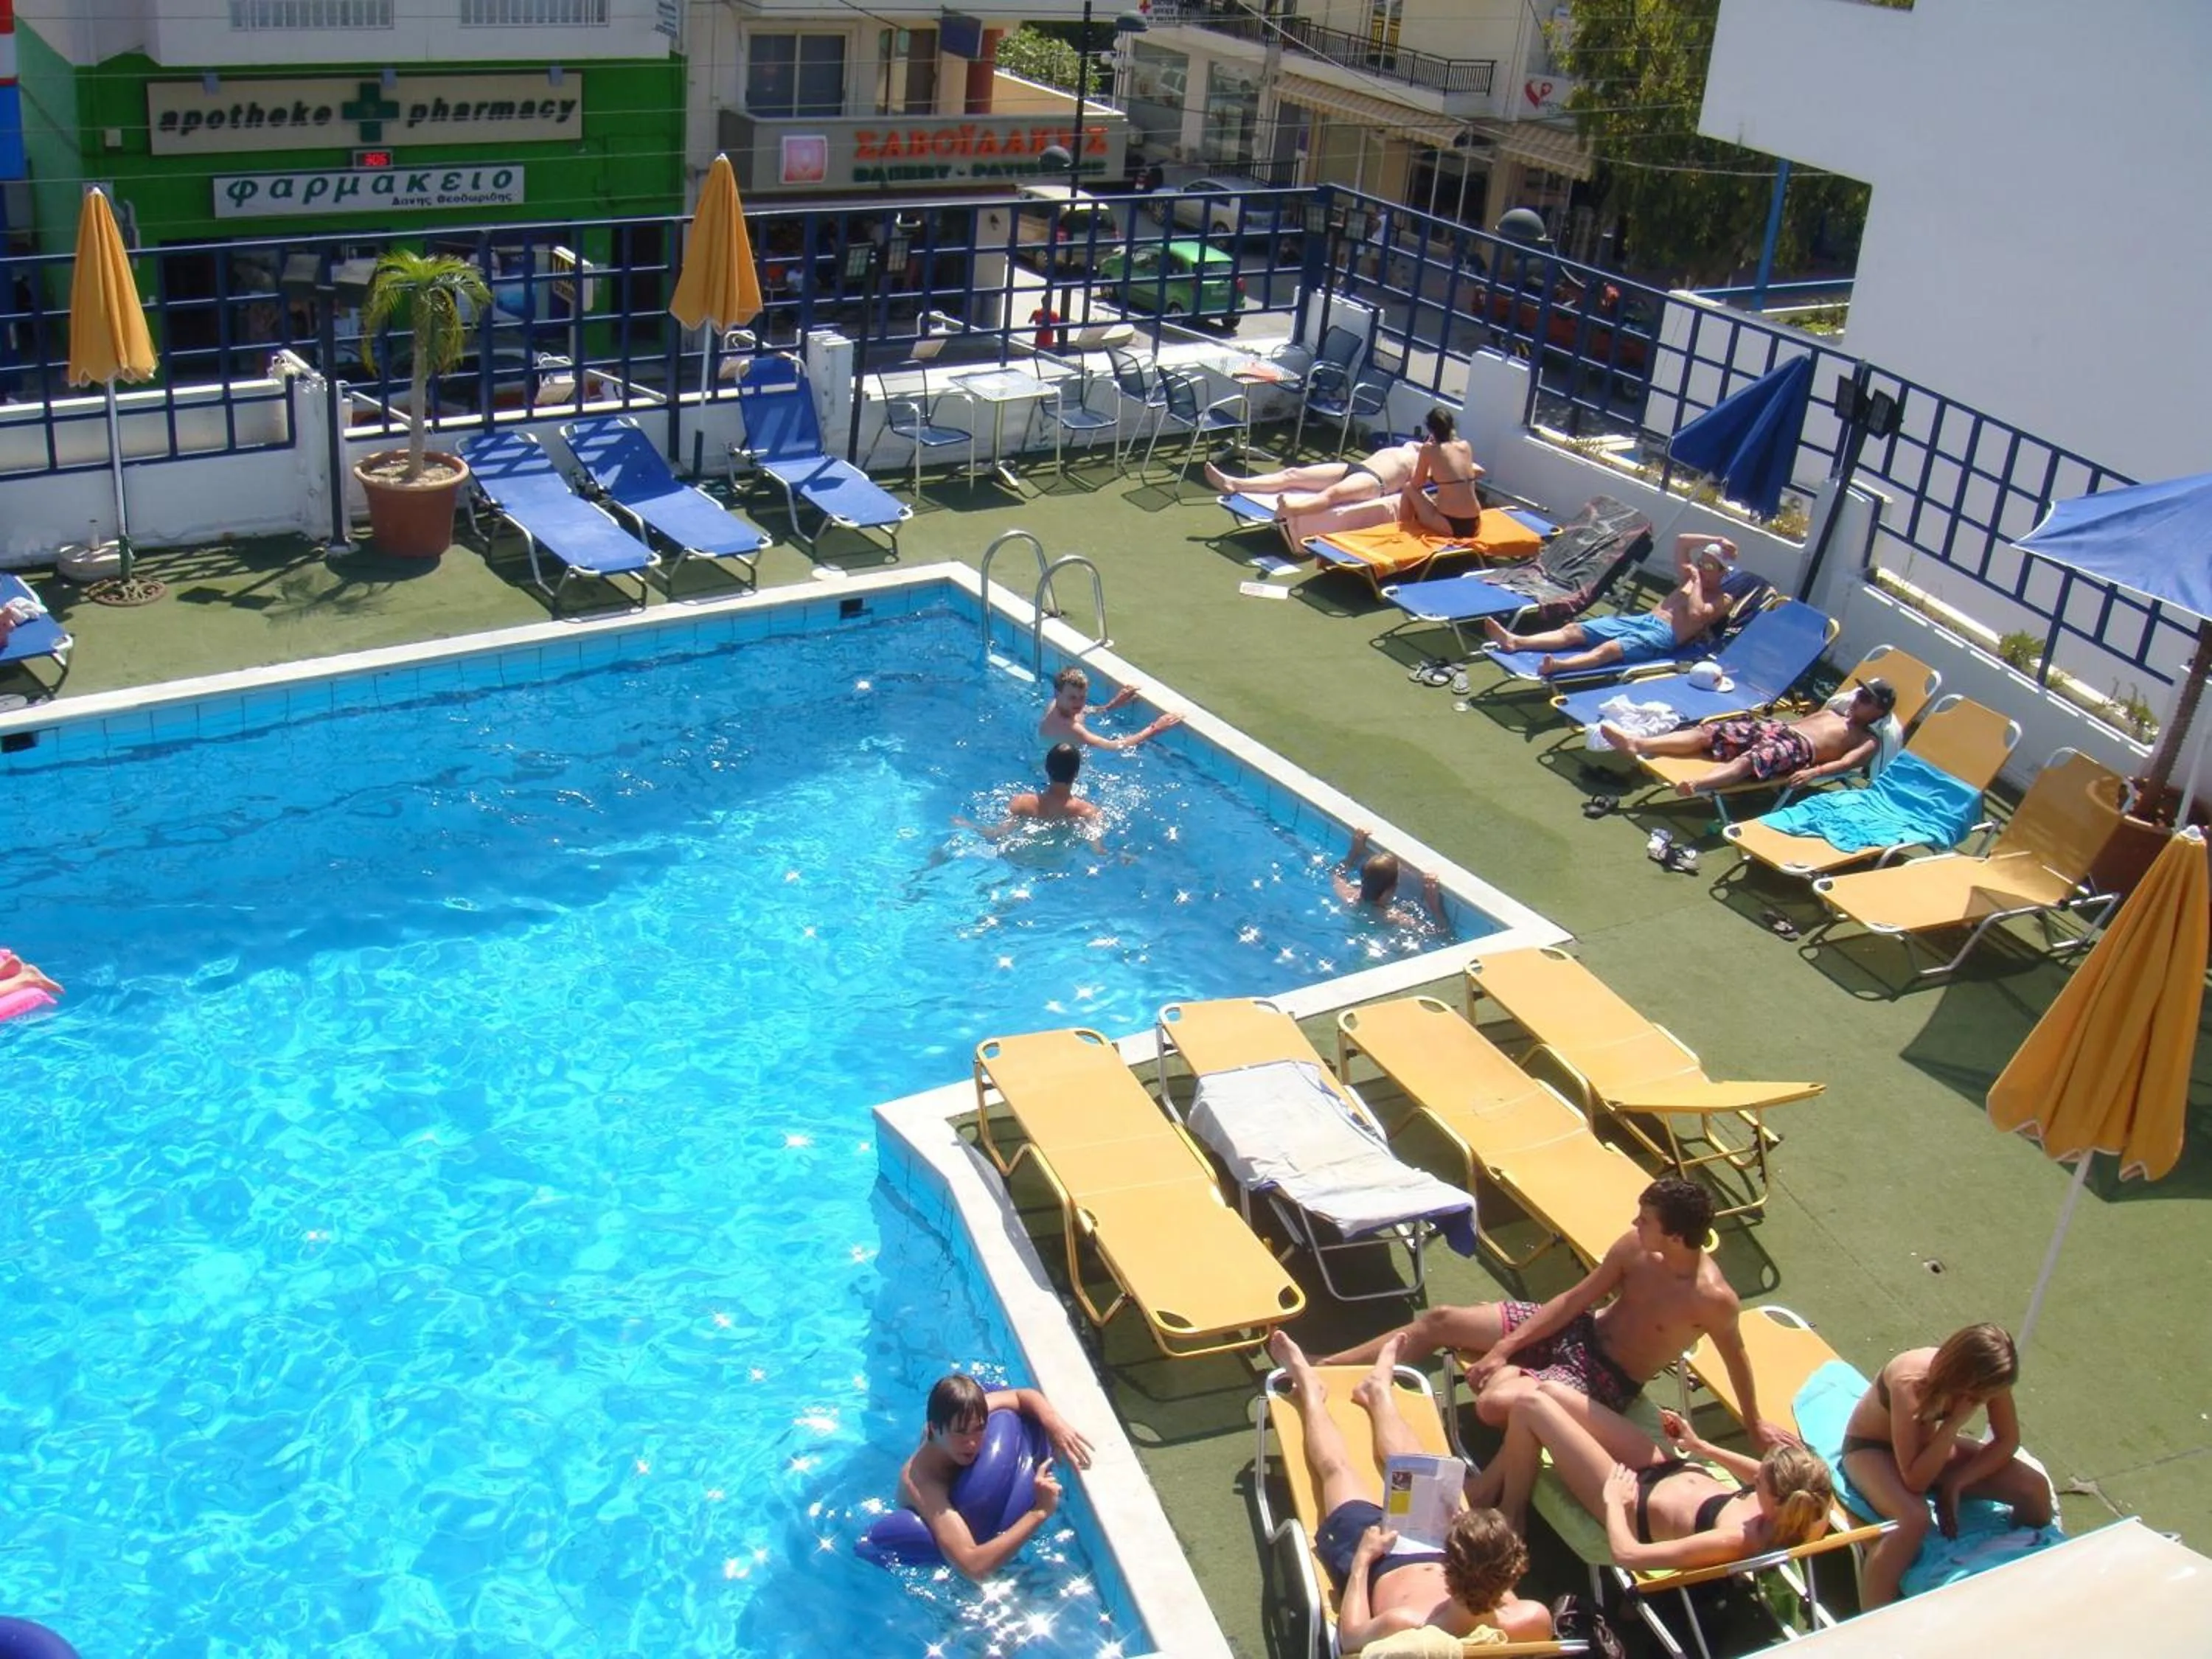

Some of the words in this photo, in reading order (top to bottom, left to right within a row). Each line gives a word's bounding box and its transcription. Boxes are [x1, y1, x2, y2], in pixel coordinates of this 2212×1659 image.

[159, 100, 332, 136] apotheke
[407, 97, 577, 128] pharmacy
[227, 170, 512, 208] φαρμακειο
